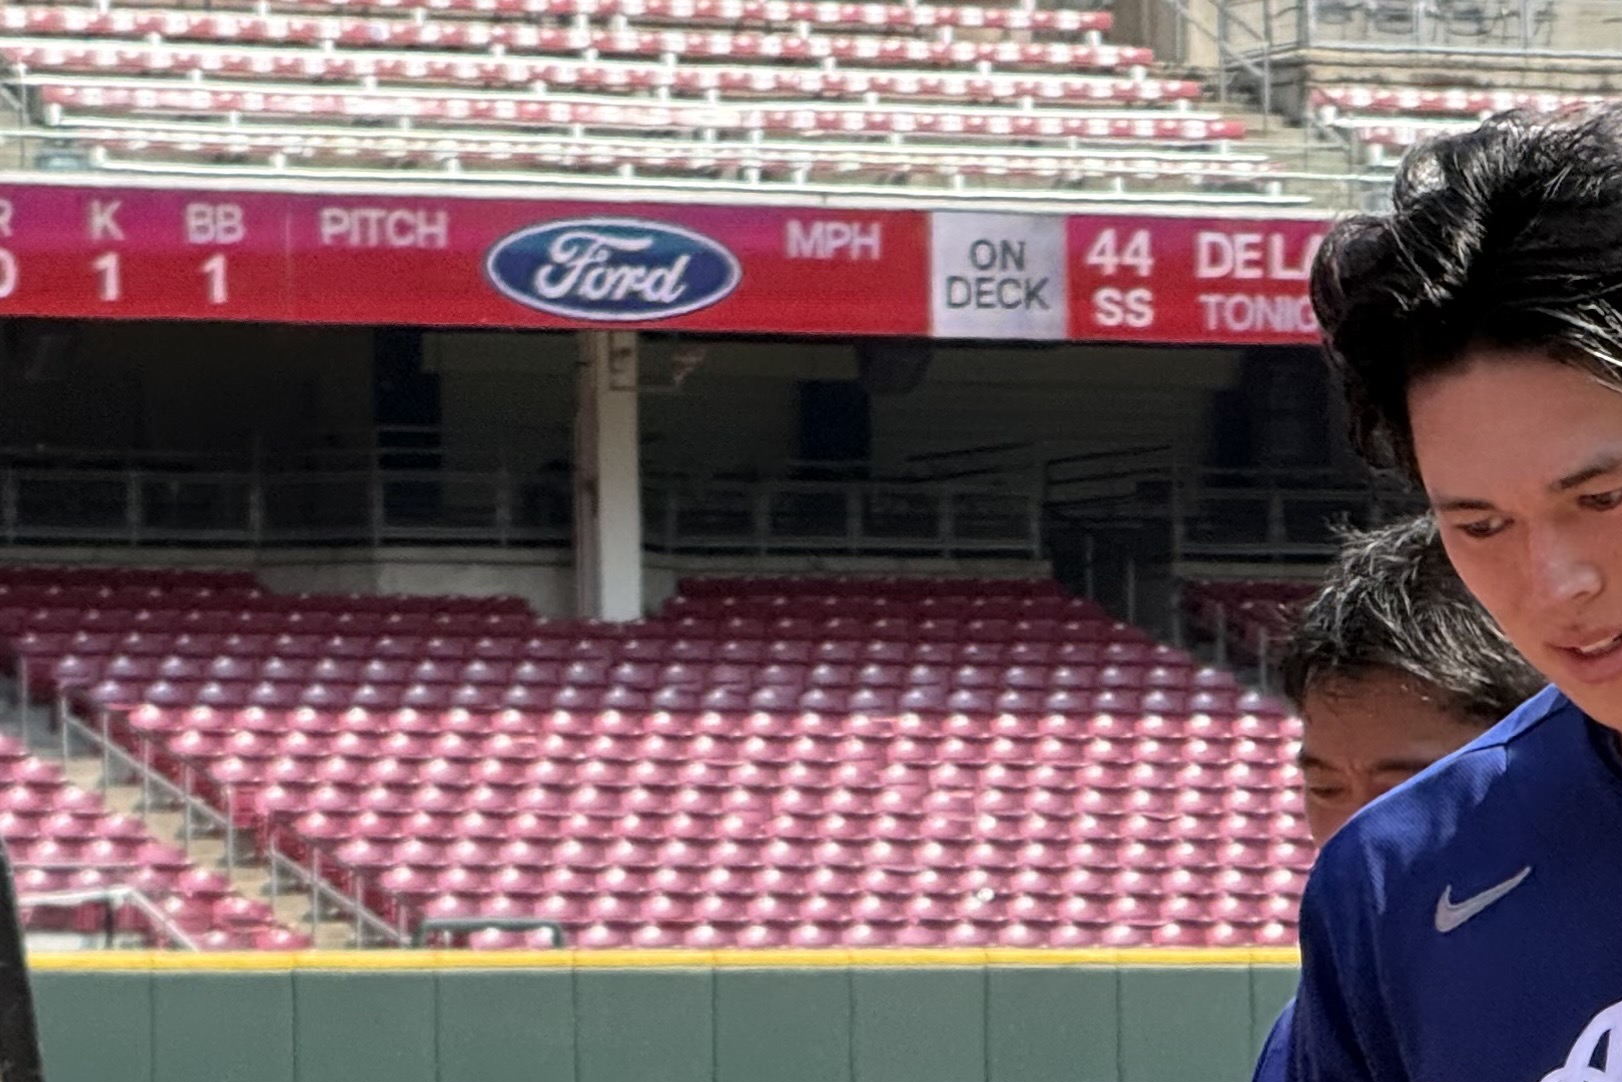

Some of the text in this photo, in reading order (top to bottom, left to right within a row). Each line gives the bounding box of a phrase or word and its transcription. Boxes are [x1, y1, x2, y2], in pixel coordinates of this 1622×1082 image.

[89, 200, 126, 242] K
[185, 202, 245, 244] BB
[319, 207, 449, 248] PITCH
[785, 219, 881, 261] MPH
[534, 230, 691, 303] Ford
[969, 238, 1026, 271] ON
[1086, 228, 1155, 276] 44
[93, 252, 120, 301] 1
[203, 254, 228, 304] 1
[945, 275, 1050, 311] DECK
[1093, 288, 1154, 328] SS
